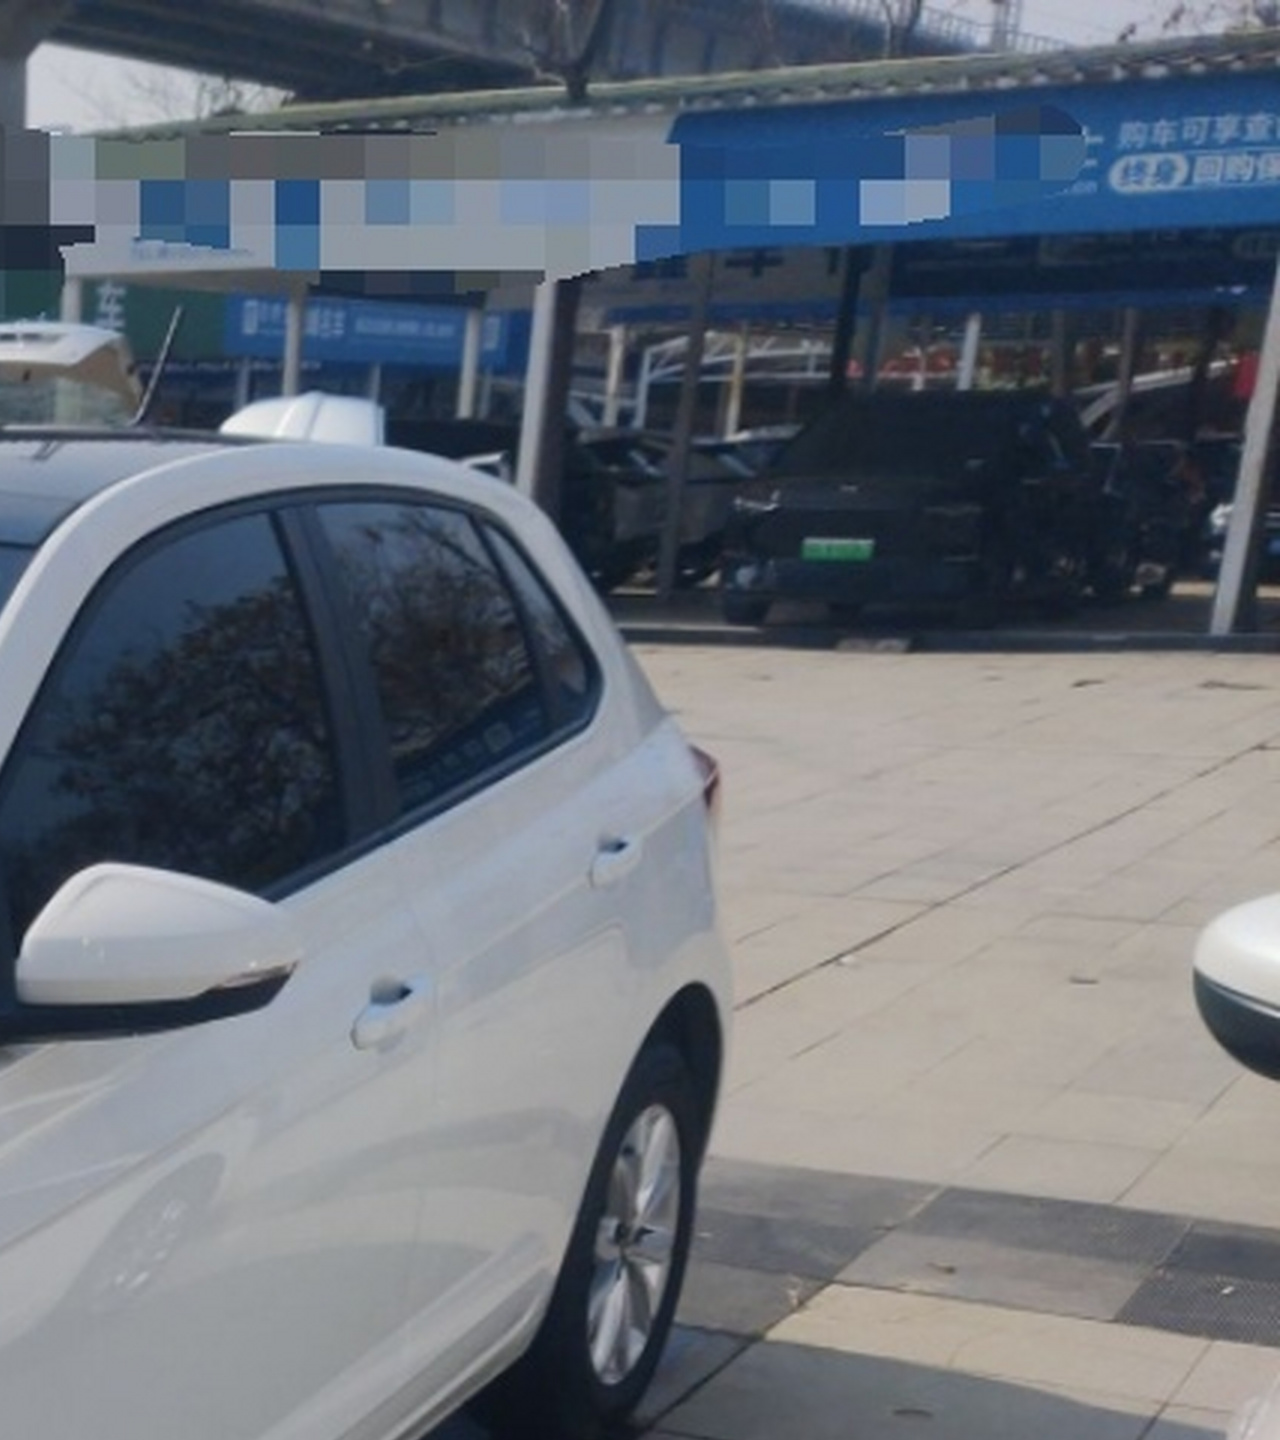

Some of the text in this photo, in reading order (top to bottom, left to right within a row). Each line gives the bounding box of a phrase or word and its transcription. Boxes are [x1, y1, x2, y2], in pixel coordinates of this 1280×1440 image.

[1117, 114, 1280, 148] 购车可享查
